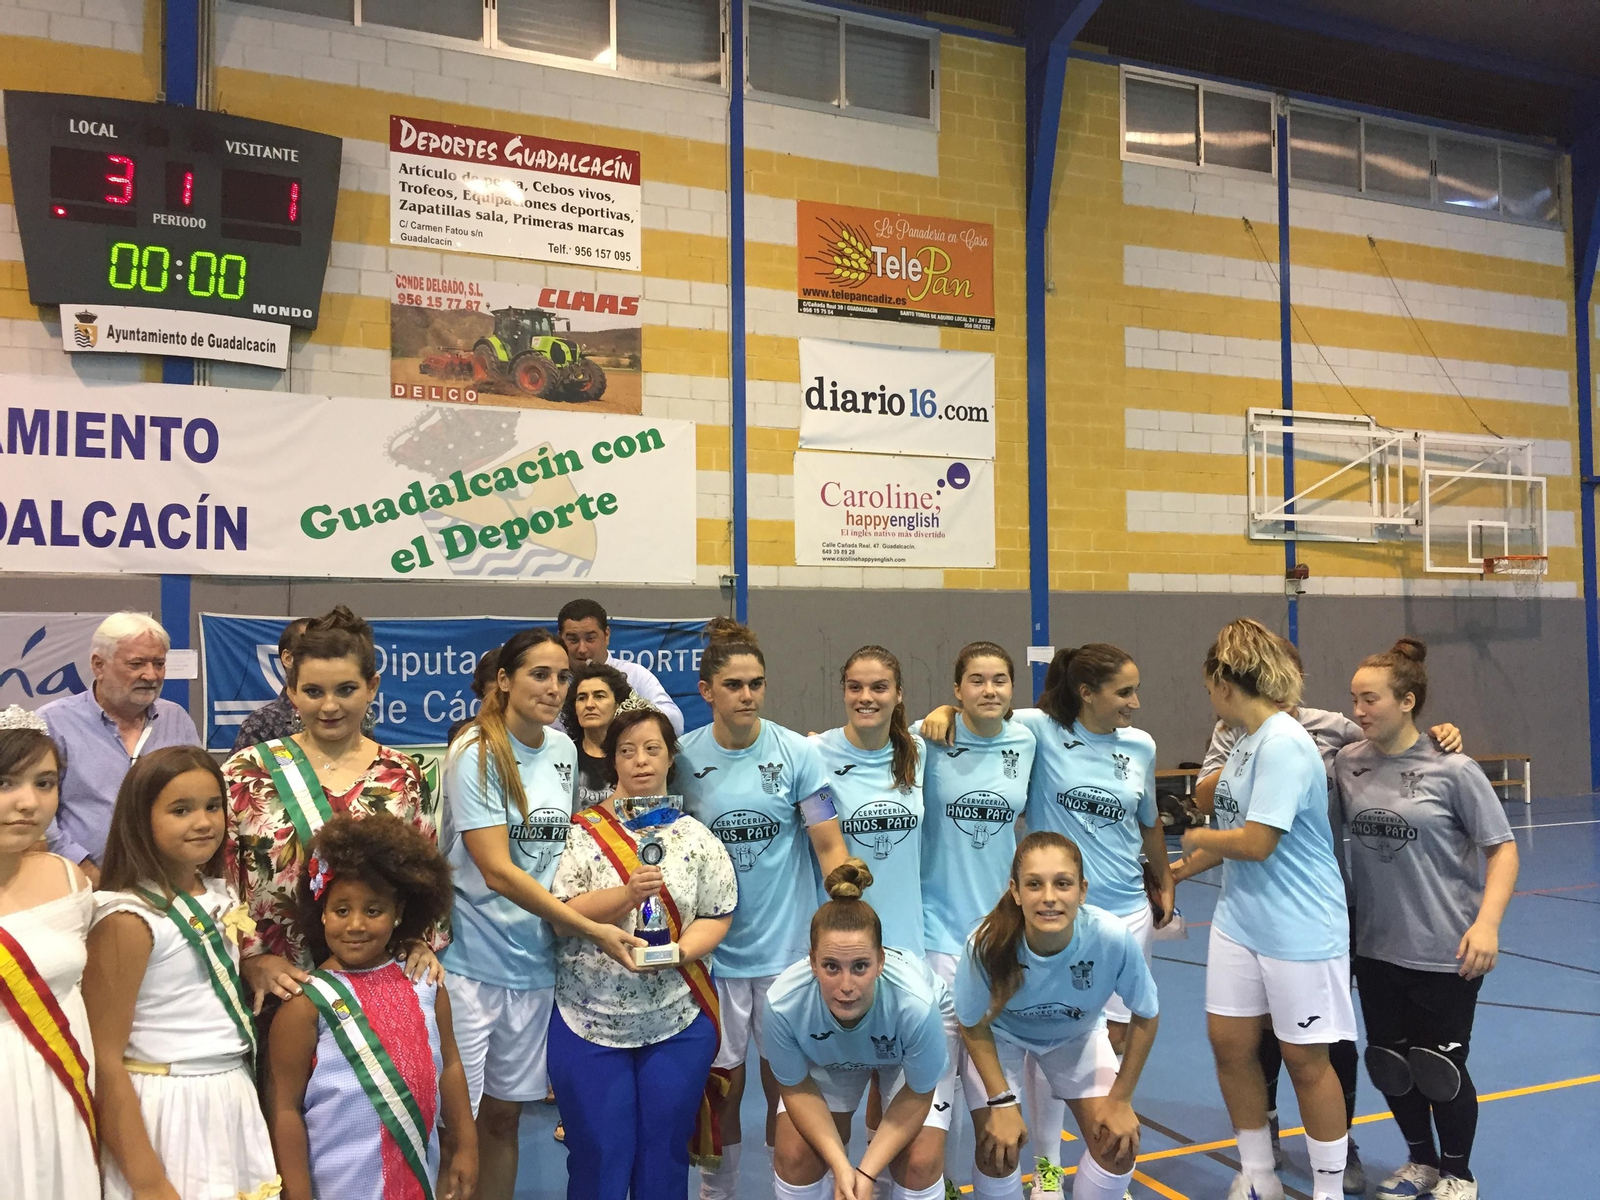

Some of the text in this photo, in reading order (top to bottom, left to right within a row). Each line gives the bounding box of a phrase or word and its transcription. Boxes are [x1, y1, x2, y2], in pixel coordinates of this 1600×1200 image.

[69, 118, 118, 139] LOCAL
[225, 140, 299, 163] VISITANTE
[399, 118, 633, 182] DEPORTES GUADALCACÍN
[105, 154, 135, 205] 3
[182, 171, 194, 206] 1
[398, 163, 457, 181] Artículo
[533, 181, 575, 197] Cebos
[578, 188, 615, 204] vivos,
[288, 181, 299, 222] 1
[398, 181, 458, 201] Trofeos,
[561, 202, 635, 224] deportivas,
[152, 212, 207, 230] PERIODO
[399, 199, 625, 238] Zapatillas sala, Primeras marcas
[399, 219, 484, 238] C/ Carmen Fatou s/n
[400, 232, 453, 246] Guadalcacín
[873, 217, 989, 252] La Panadería en Casa
[574, 245, 592, 258] 956
[595, 248, 611, 259] 157
[614, 250, 632, 262] 095
[108, 242, 247, 300] 00:00
[395, 274, 483, 298] CONDE DELGADO, S.L.
[802, 286, 907, 306] www.telepancadiz.es
[252, 303, 313, 319] MONDO
[397, 292, 481, 312] 956 15 77 87
[537, 287, 639, 316] CLAAS
[106, 324, 277, 354] Ayuntamiento de Guadalcacín
[394, 384, 477, 402] DELCO
[0, 407, 219, 464] MIENTO
[299, 427, 666, 540] Guadalcacín con
[820, 481, 941, 515] Caroline,
[846, 510, 940, 531] happyenglish
[390, 491, 620, 574] el Deporte
[850, 529, 872, 538] inglés
[898, 530, 912, 538] más
[914, 530, 946, 538] divertido
[373, 644, 490, 682] Diputa
[857, 806, 906, 817] CERVECERÍA
[947, 805, 1013, 821] HNOS. PATO
[1057, 794, 1124, 820] HNOS. PATO
[510, 825, 547, 839] HNOS.
[746, 824, 779, 840] PATO
[843, 816, 917, 833] HNOS. PATO
[1385, 826, 1416, 840] PATO
